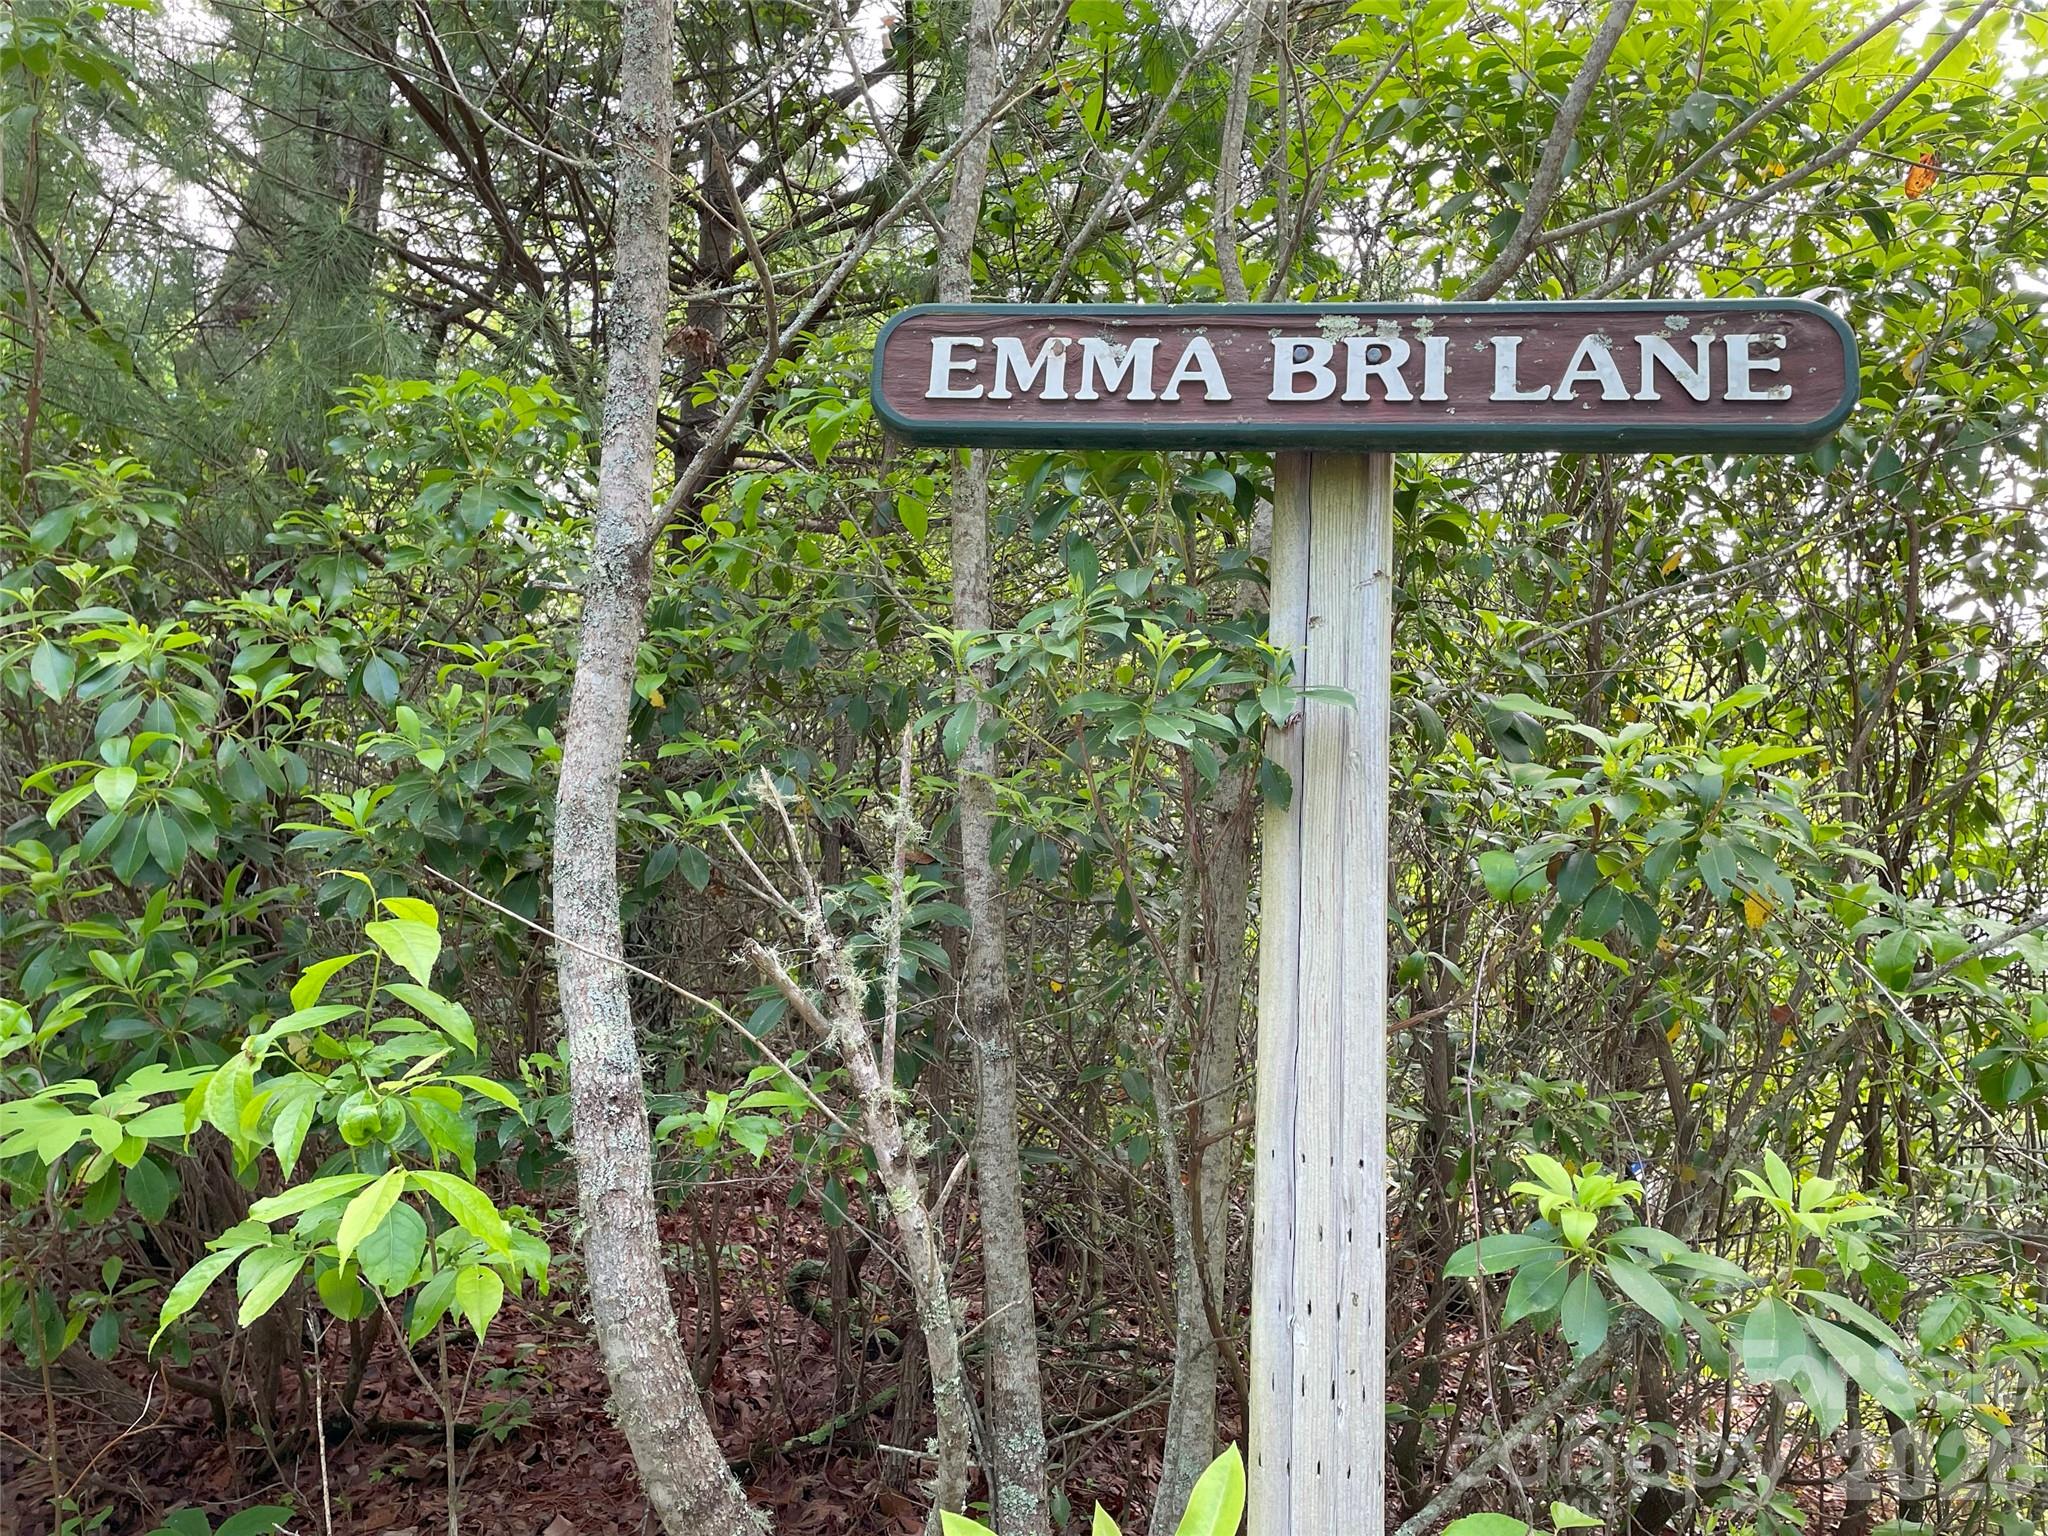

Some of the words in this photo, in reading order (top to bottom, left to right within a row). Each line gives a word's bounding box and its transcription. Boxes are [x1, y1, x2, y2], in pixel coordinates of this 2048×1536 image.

[925, 336, 1232, 401] EMMA
[1267, 335, 1450, 402] BRI
[1489, 334, 1793, 402] LANE
